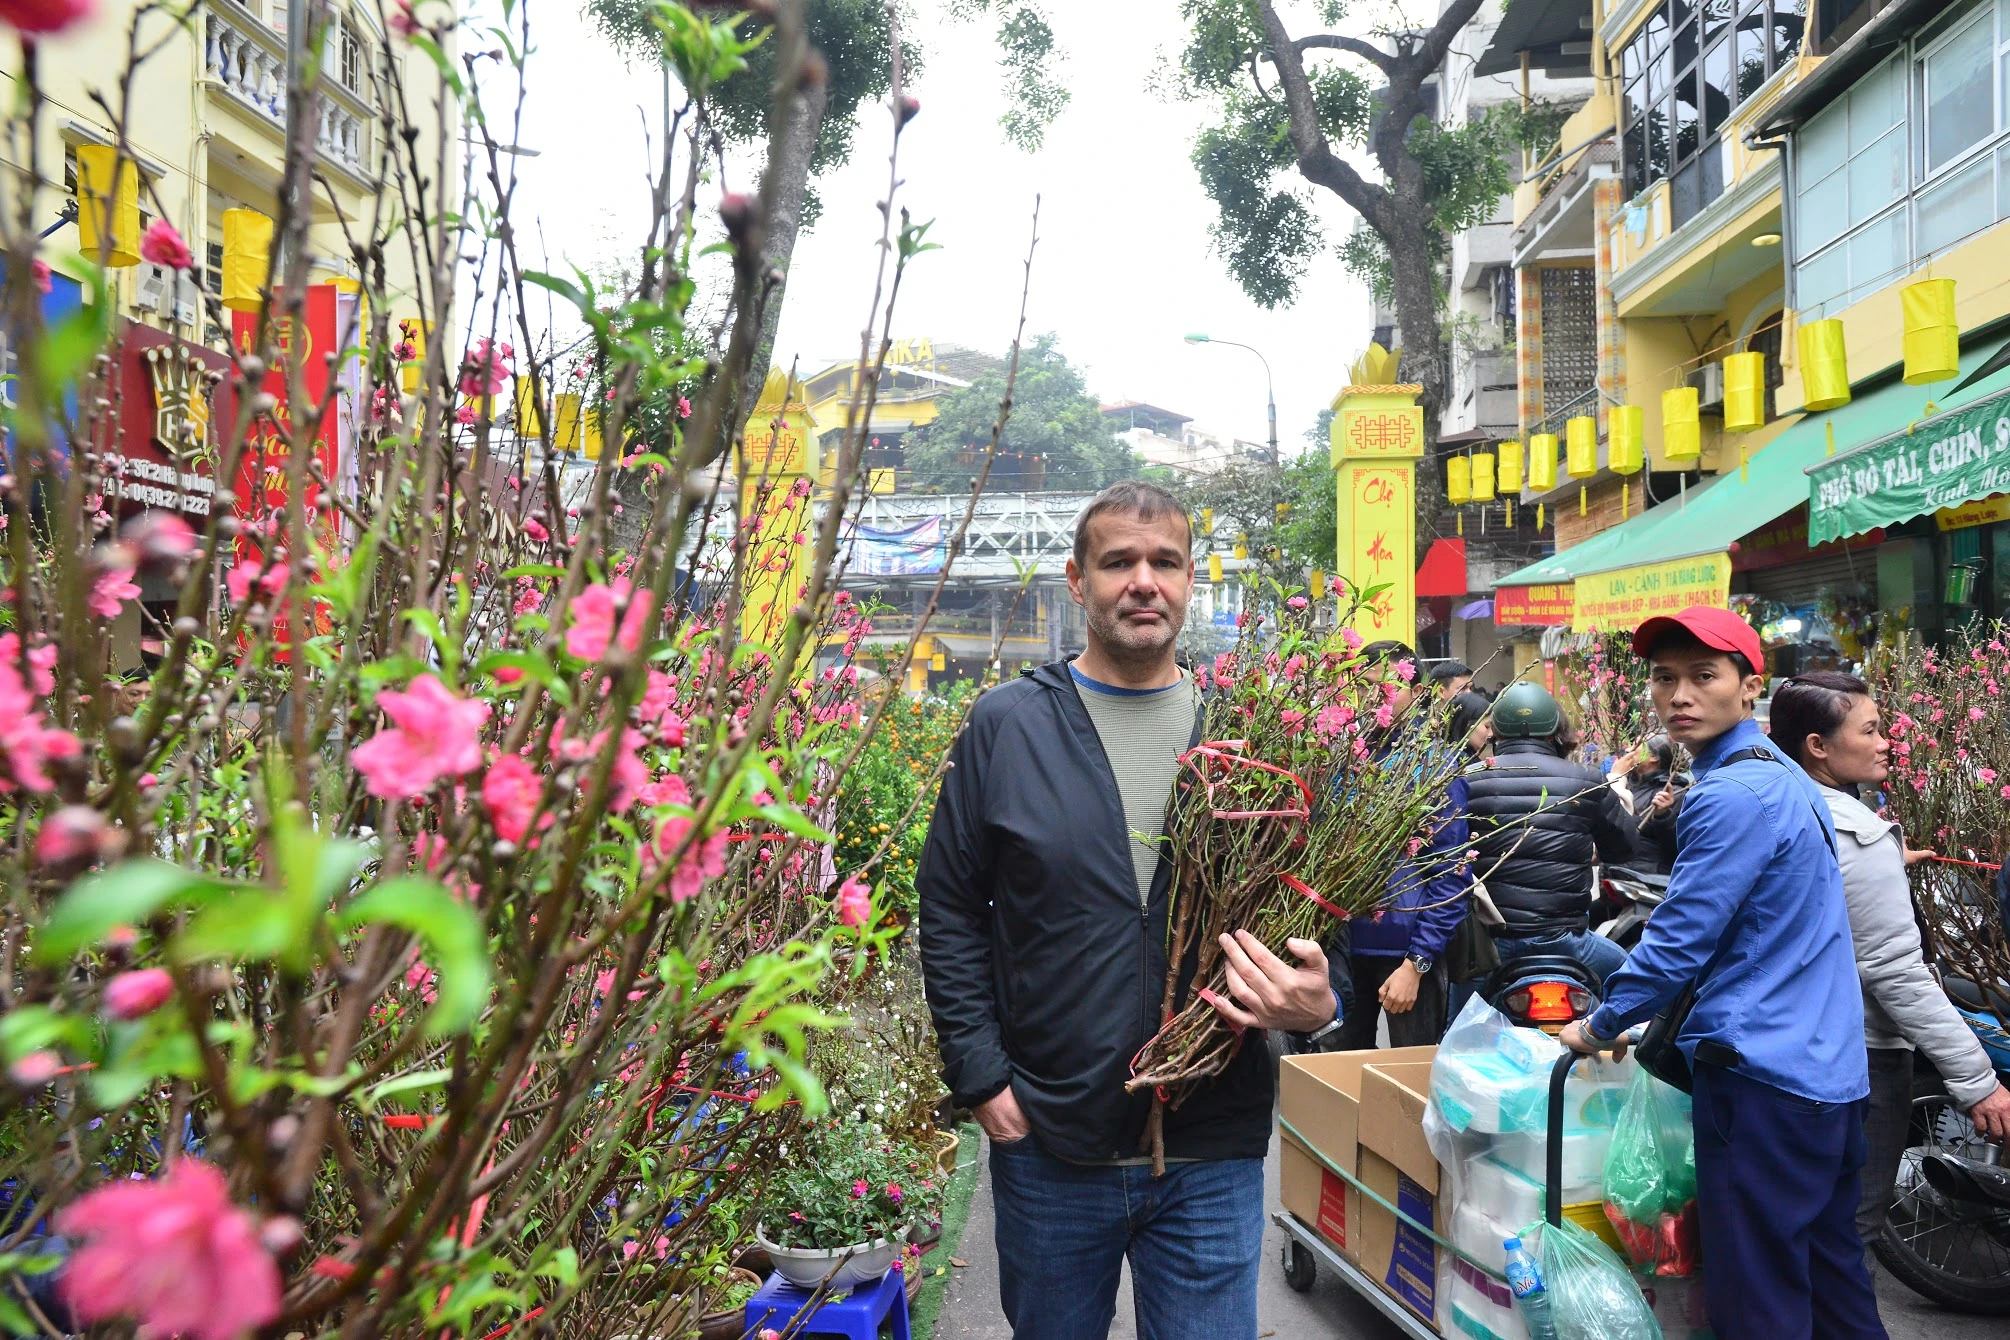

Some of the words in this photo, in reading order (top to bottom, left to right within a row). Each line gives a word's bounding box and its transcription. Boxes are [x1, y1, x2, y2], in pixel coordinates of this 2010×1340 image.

[1855, 457, 1880, 499] BÒ
[1883, 446, 1923, 487] TÁI,
[1928, 424, 1989, 474] CHÍN,
[1364, 478, 1395, 508] Chợ
[1366, 530, 1393, 576] Hoa
[1609, 578, 1626, 596] LAN
